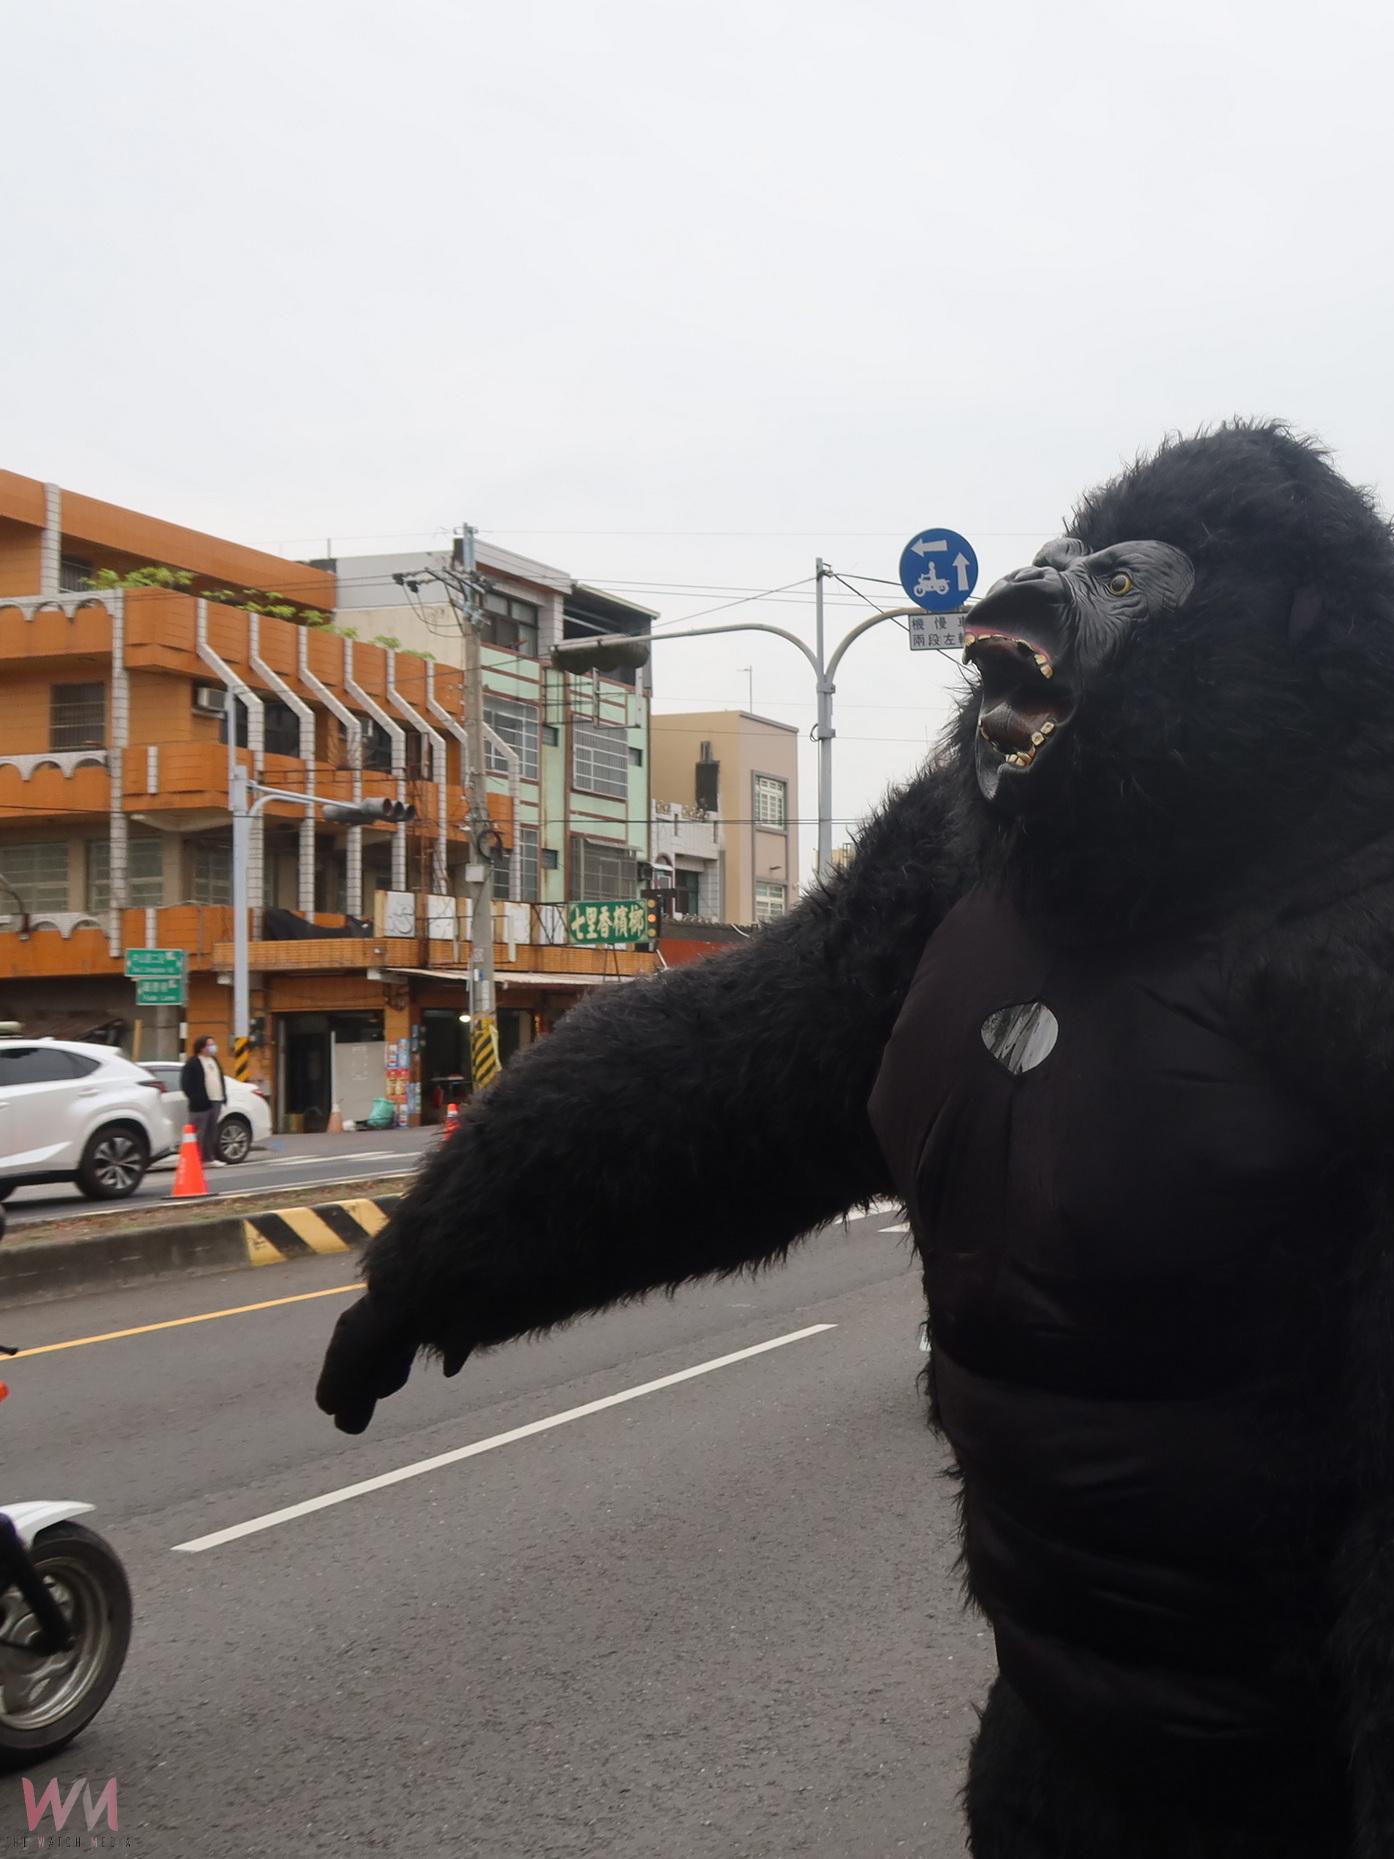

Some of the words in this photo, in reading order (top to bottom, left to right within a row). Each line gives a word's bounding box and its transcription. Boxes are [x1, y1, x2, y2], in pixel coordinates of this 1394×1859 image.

[913, 632, 966, 647] 兩段左
[570, 902, 645, 941] 七里香檳榔
